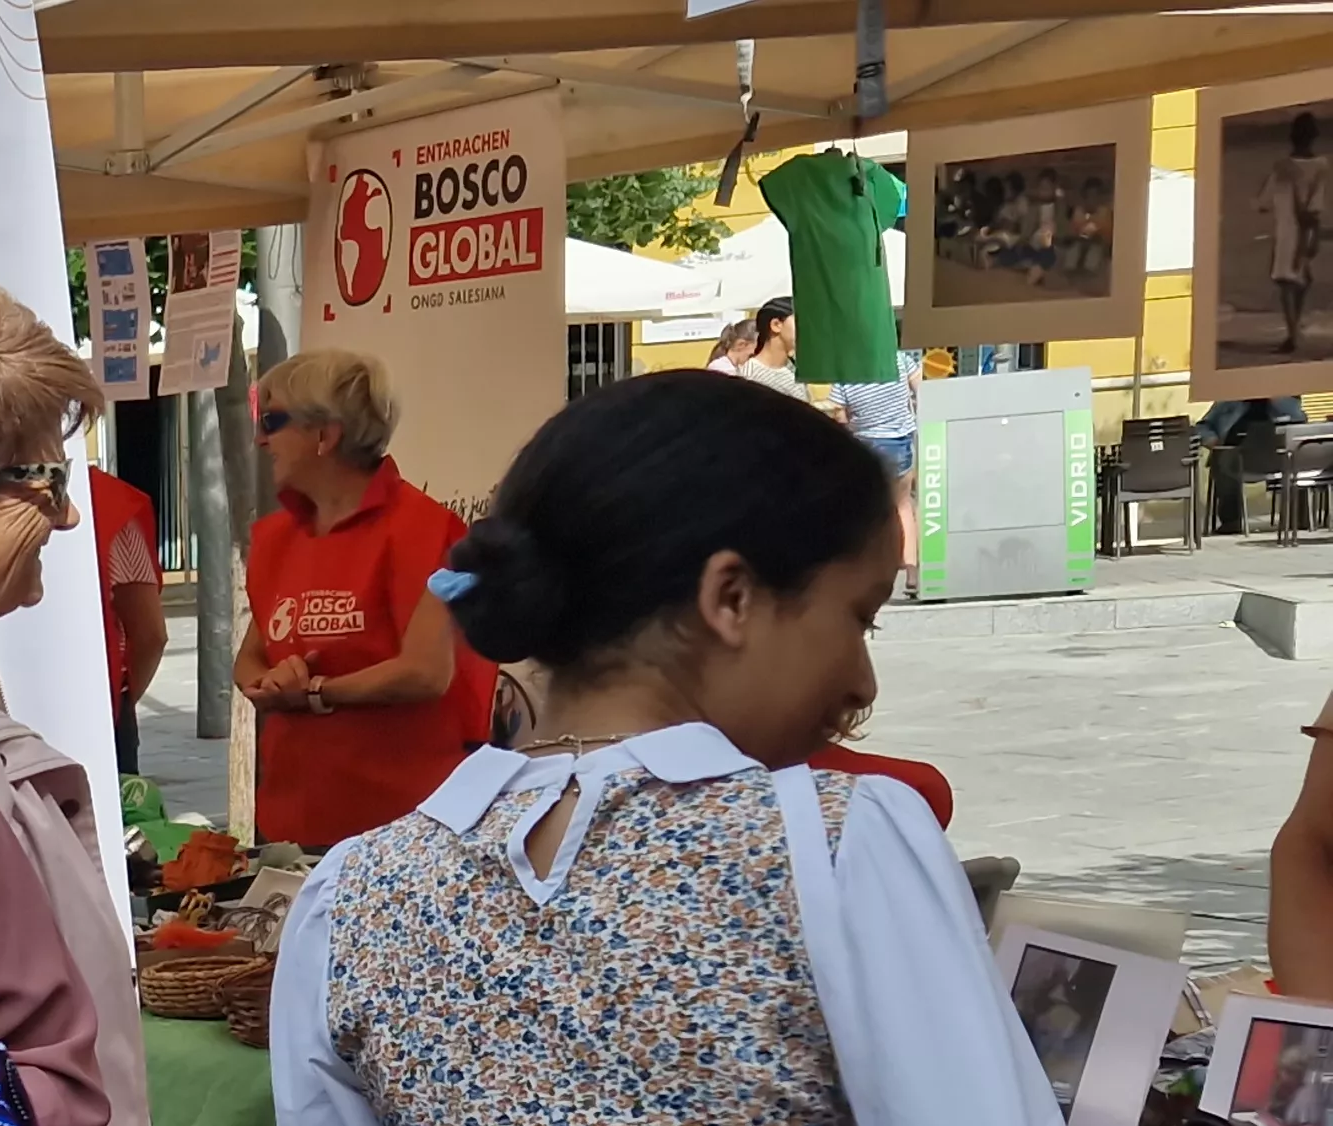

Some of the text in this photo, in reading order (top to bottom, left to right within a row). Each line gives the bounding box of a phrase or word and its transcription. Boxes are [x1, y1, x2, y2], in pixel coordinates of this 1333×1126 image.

[416, 128, 511, 165] ENTARACHEN
[414, 154, 528, 220] BOSCO
[412, 217, 537, 279] GLOBAL
[410, 285, 506, 310] ONGD SALESIANA
[924, 443, 942, 537] VIDRIO
[1069, 432, 1088, 527] VIDRIO
[298, 614, 362, 633] GLOBAL
